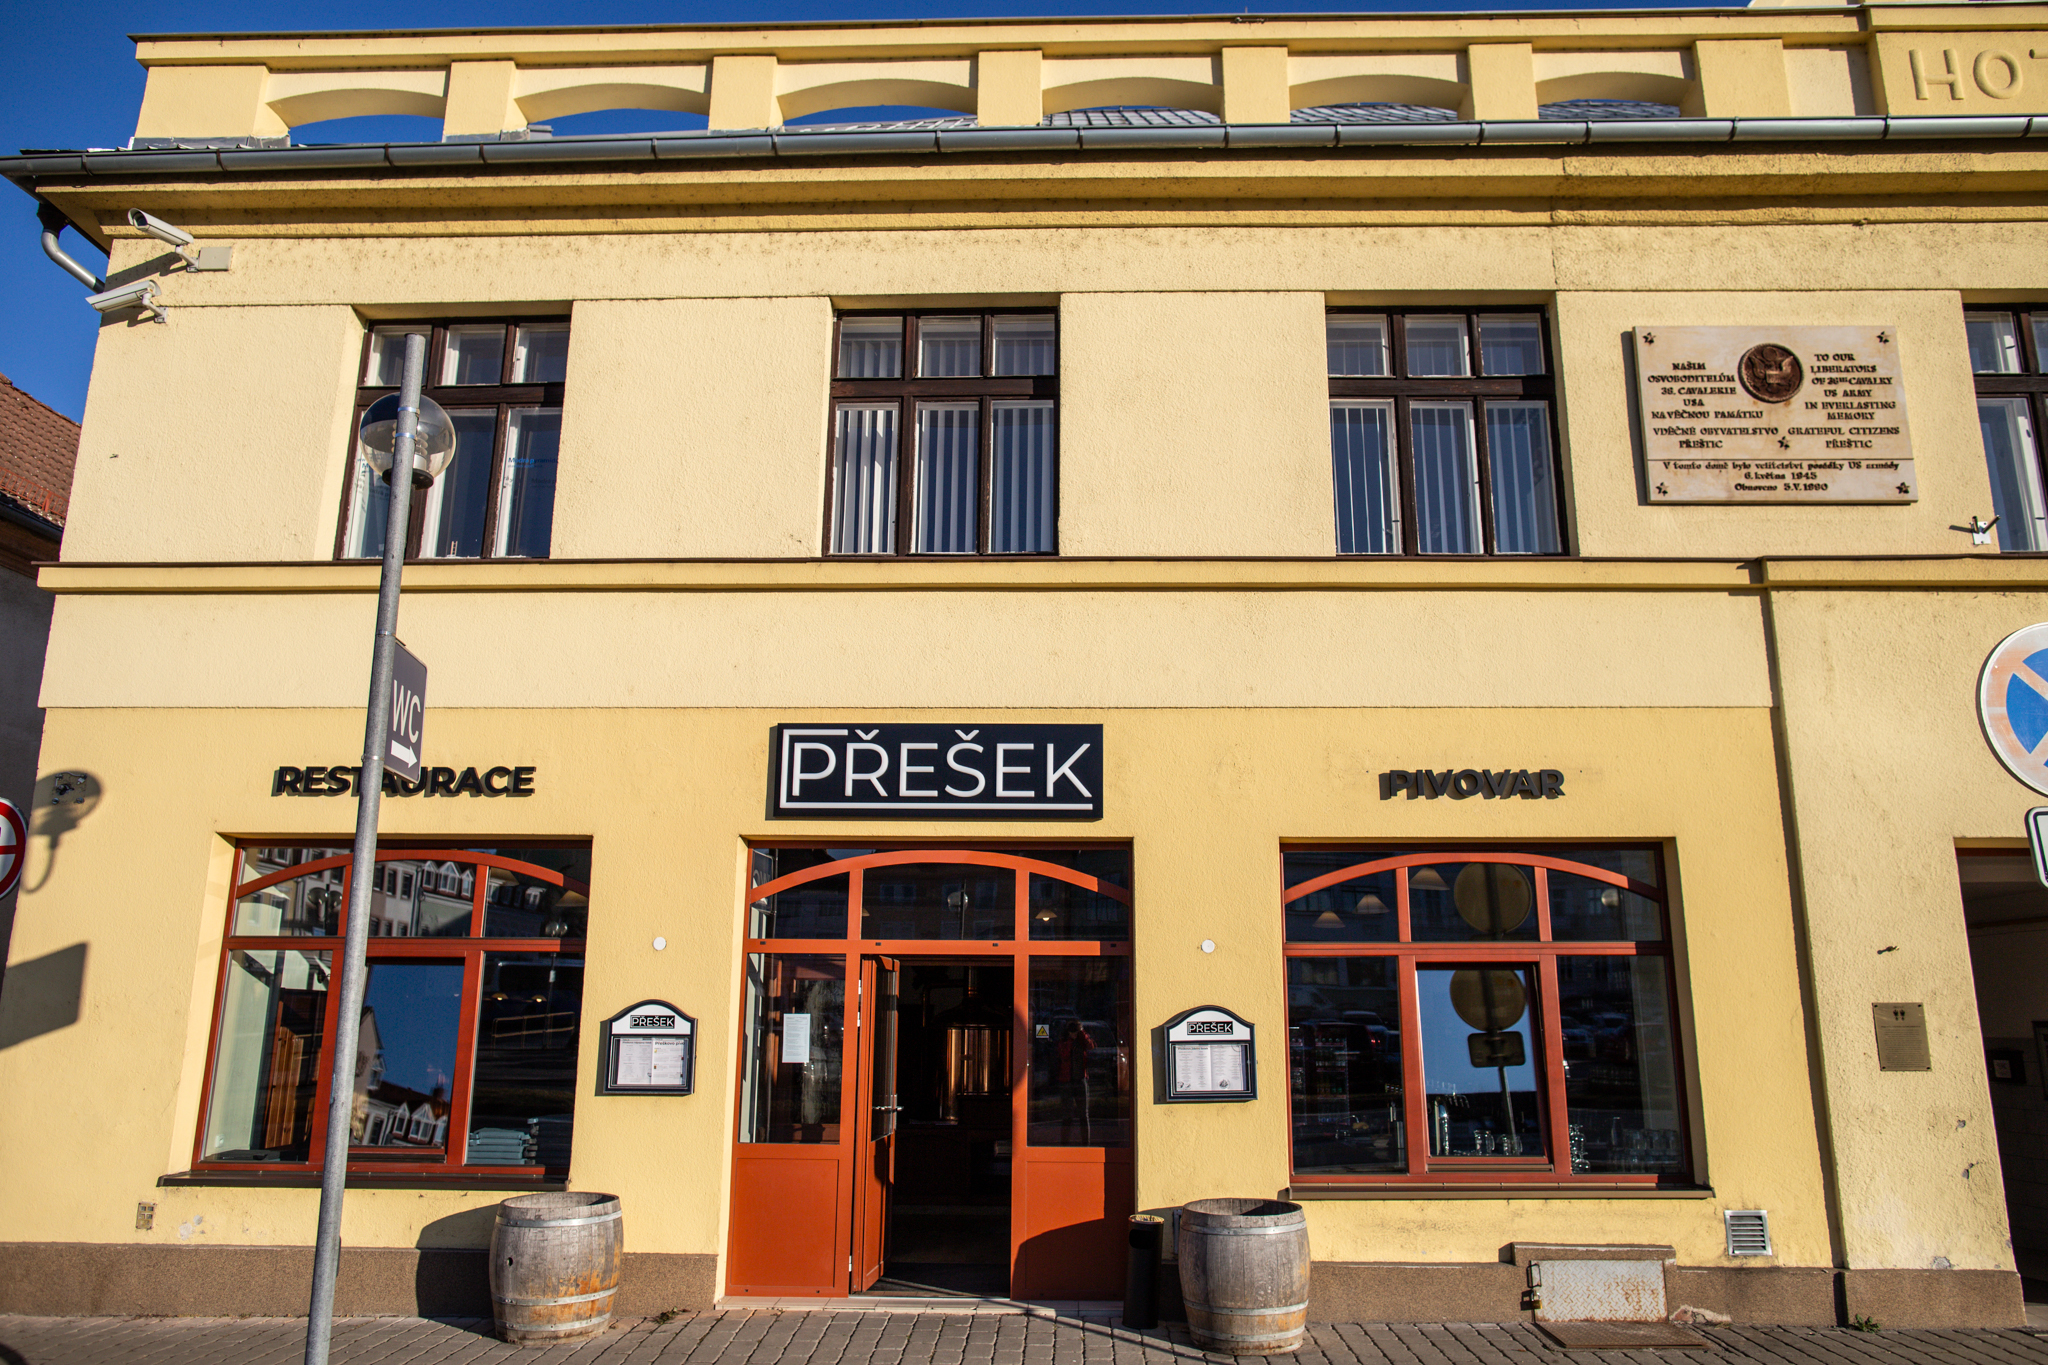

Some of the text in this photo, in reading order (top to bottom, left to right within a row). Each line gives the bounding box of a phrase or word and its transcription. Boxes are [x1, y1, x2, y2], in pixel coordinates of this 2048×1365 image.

[1908, 48, 2048, 101] HO
[1814, 353, 1856, 362] TO OUR
[1672, 361, 1707, 371] NAŠIM
[1810, 364, 1877, 373] LIBERATORS
[1811, 376, 1826, 385] OF
[1848, 376, 1893, 385] CAVALRY
[1678, 386, 1737, 395] CAVALERIE
[1824, 389, 1873, 398] US ARMY
[1683, 398, 1705, 407] USA
[1804, 401, 1896, 410] IN EVERLASTING
[1651, 408, 1764, 419] NA VĚČNOU PAMÁTKU
[1827, 411, 1876, 420] MEMORY
[1653, 426, 1779, 436] VDĚČNÉ OBYVATELSTVO
[1787, 426, 1900, 436] GRATEFUL CITIZENS
[1678, 438, 1723, 449] PŘEŠTIC
[1825, 438, 1873, 448] PŘEŠTIC
[1663, 461, 1671, 470] V
[1673, 461, 1702, 470] tomto
[1705, 461, 1729, 470] domě
[1732, 461, 1752, 471] bylo
[1754, 461, 1804, 470] velitelství
[1848, 460, 1862, 470] US
[1754, 471, 1786, 480] května
[1791, 471, 1818, 480] 1945
[1734, 482, 1778, 491] Obnoveno
[393, 679, 421, 744] WC
[791, 728, 1093, 798] PŘEŠEK
[1388, 768, 1566, 797] PIVOVAR
[631, 1015, 675, 1027] PŘEŠEK
[1188, 1021, 1233, 1034] PŘEŠEK
